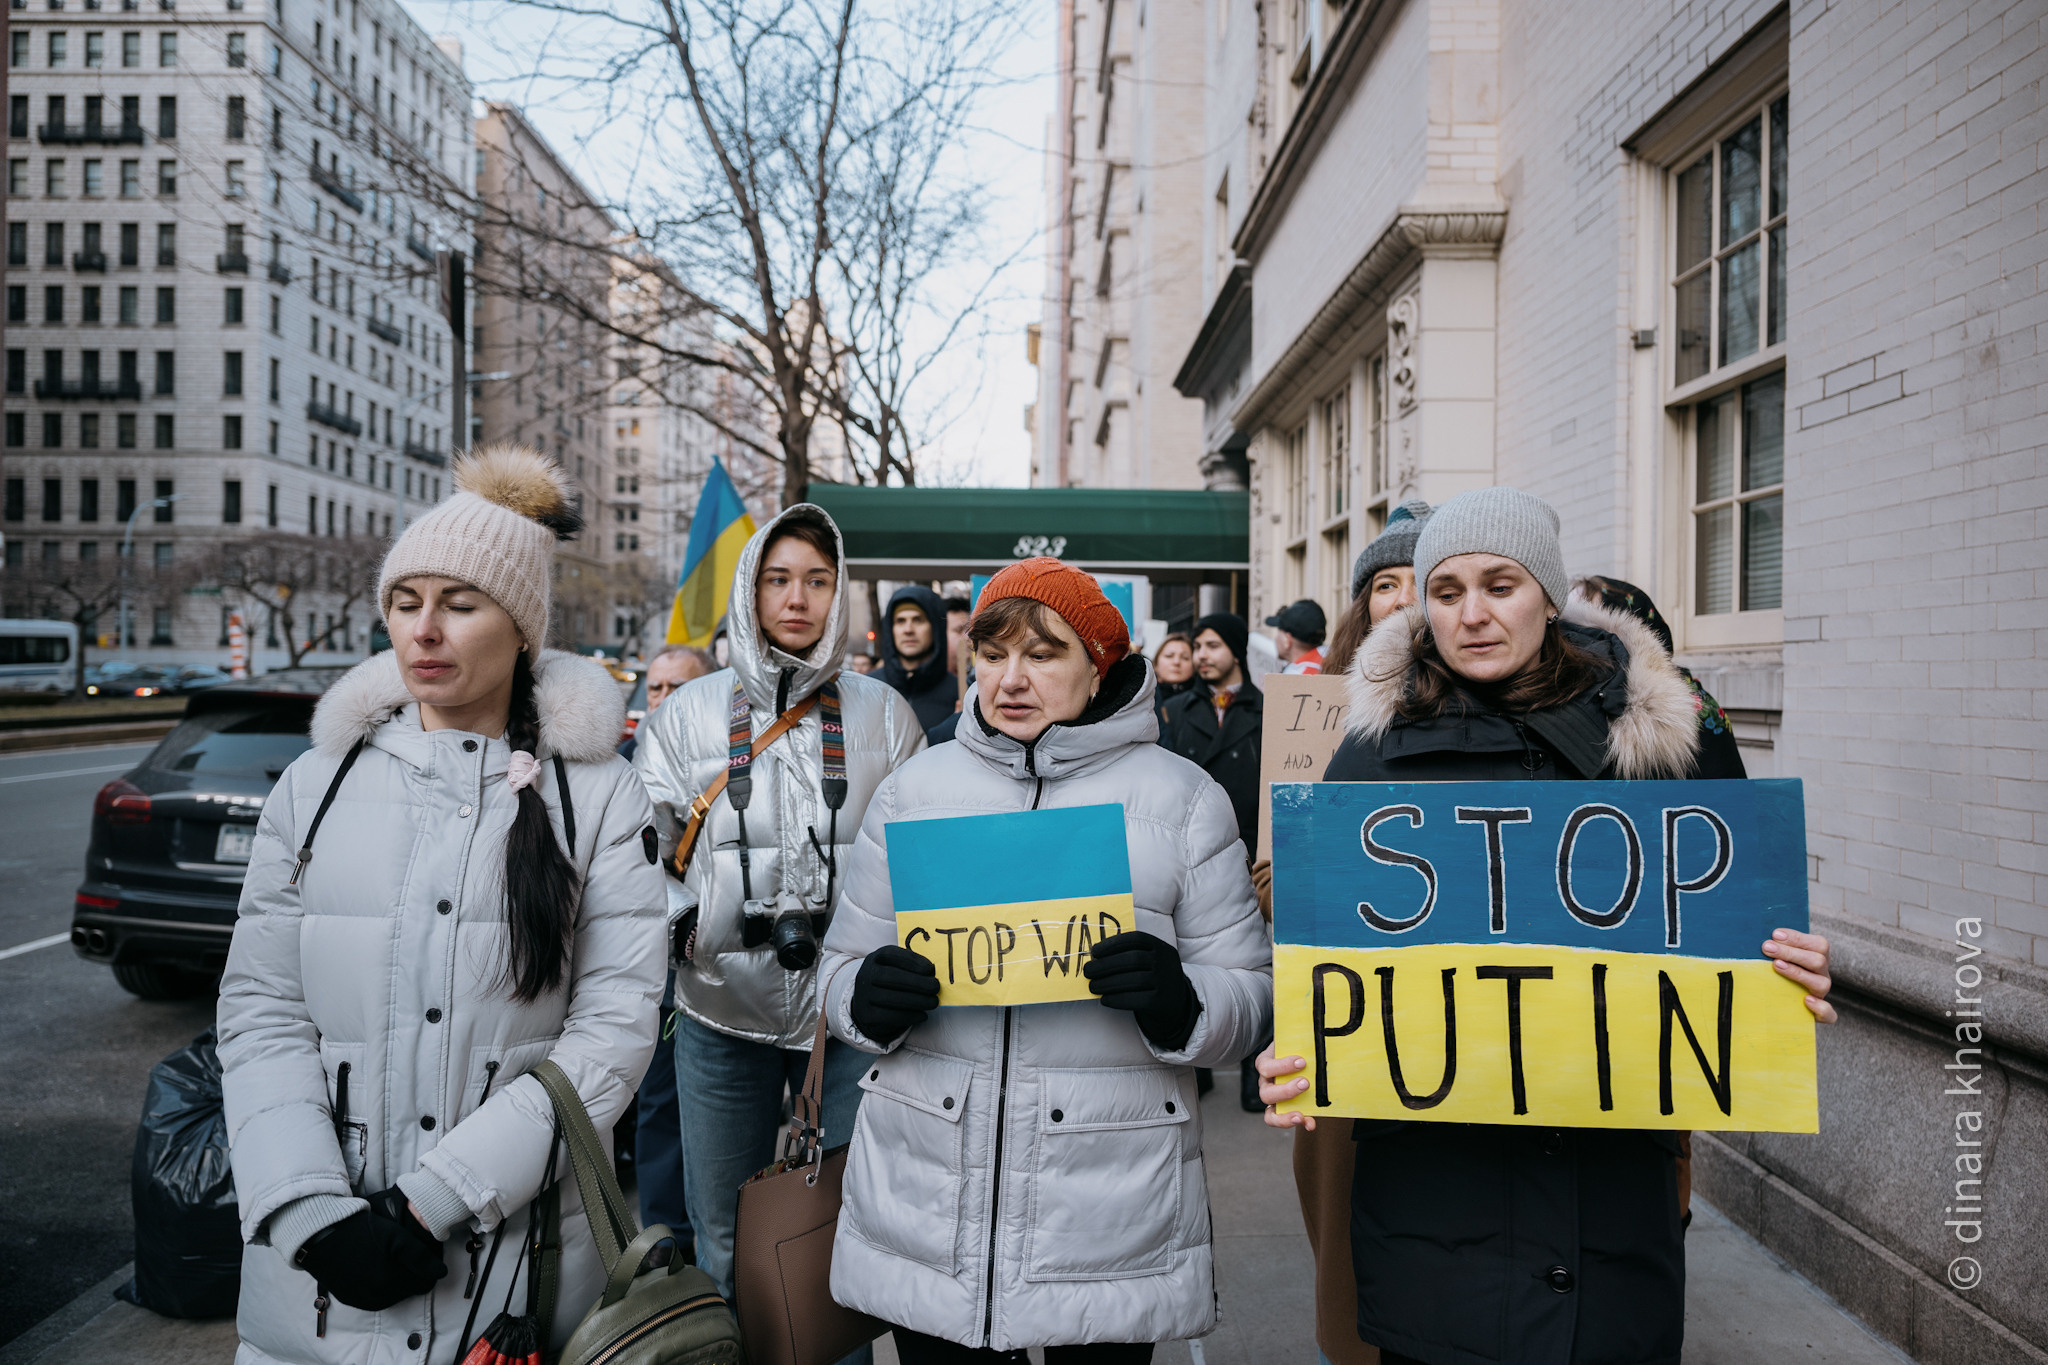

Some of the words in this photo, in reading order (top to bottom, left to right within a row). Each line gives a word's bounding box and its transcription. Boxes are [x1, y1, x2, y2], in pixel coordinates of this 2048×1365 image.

[1013, 535, 1067, 558] 823
[1283, 753, 1313, 770] AND
[1357, 802, 1733, 949] STOP
[1312, 962, 1733, 1117] PUTIN
